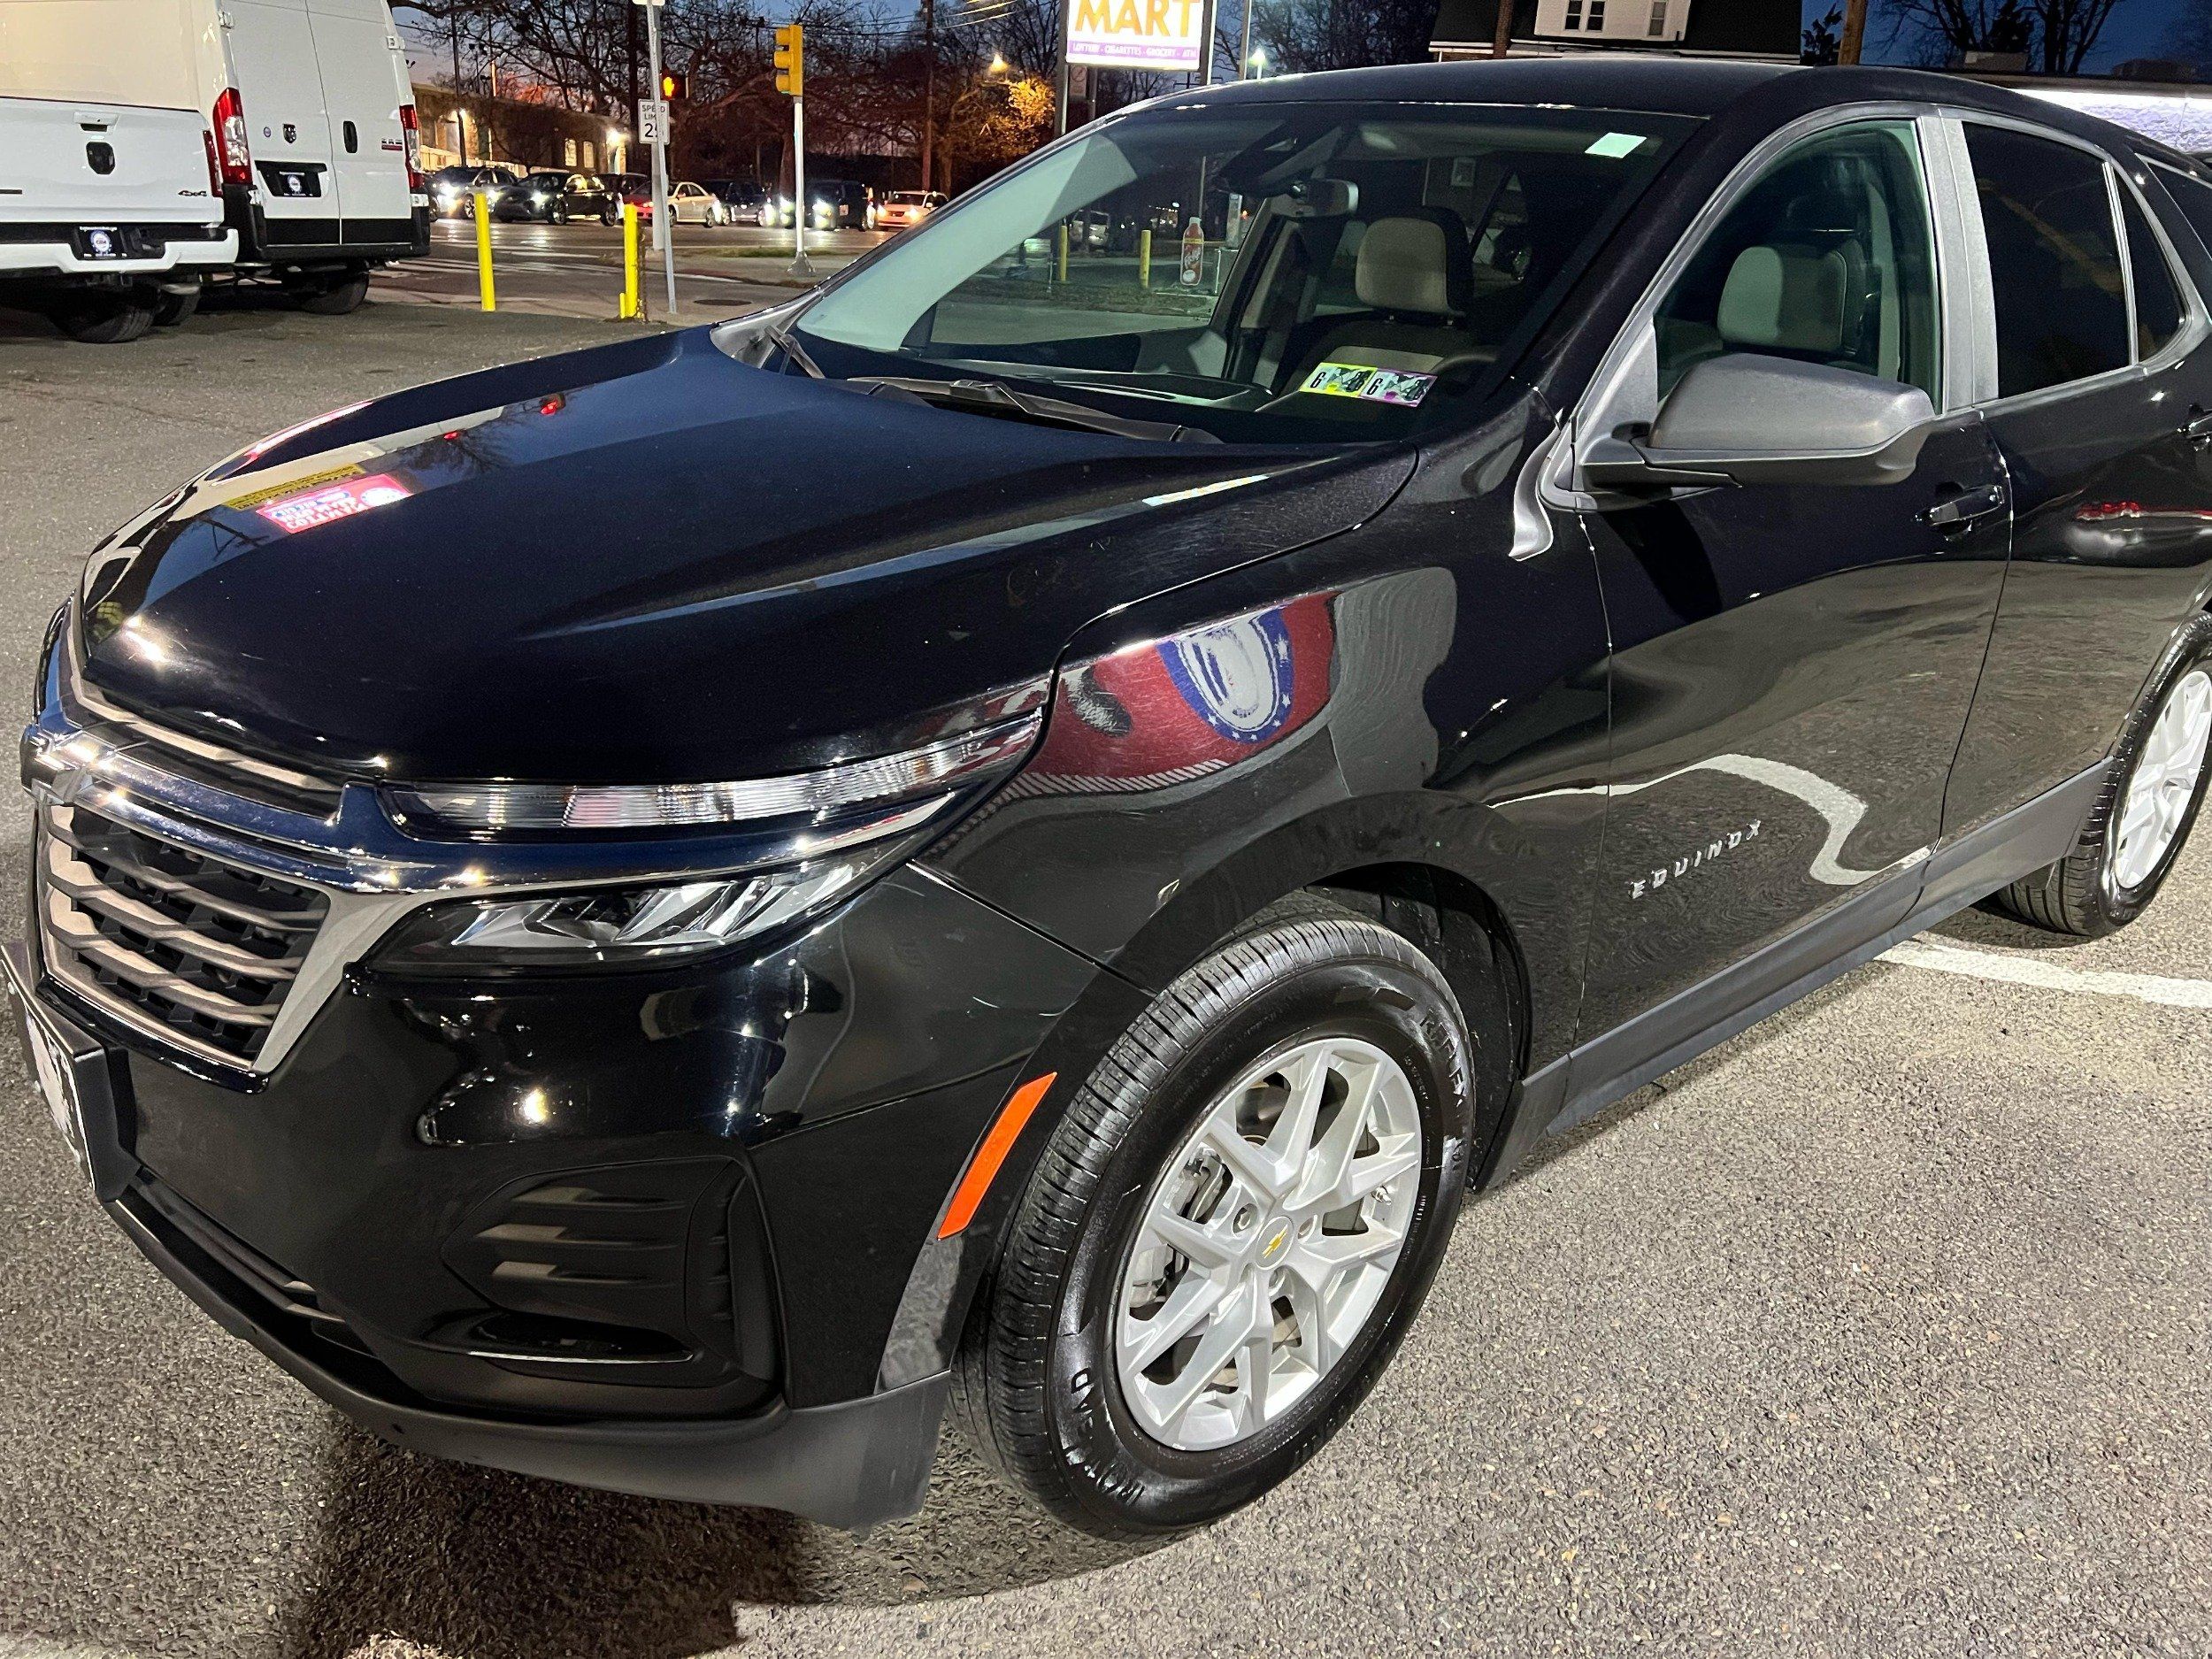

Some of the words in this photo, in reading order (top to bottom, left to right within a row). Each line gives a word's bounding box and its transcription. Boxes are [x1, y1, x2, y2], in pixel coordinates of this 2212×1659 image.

[1074, 0, 1200, 38] MART
[1181, 49, 1197, 58] ATM
[1310, 372, 1326, 388] 6
[1366, 378, 1383, 396] 6
[1629, 818, 1762, 900] EQUINOX
